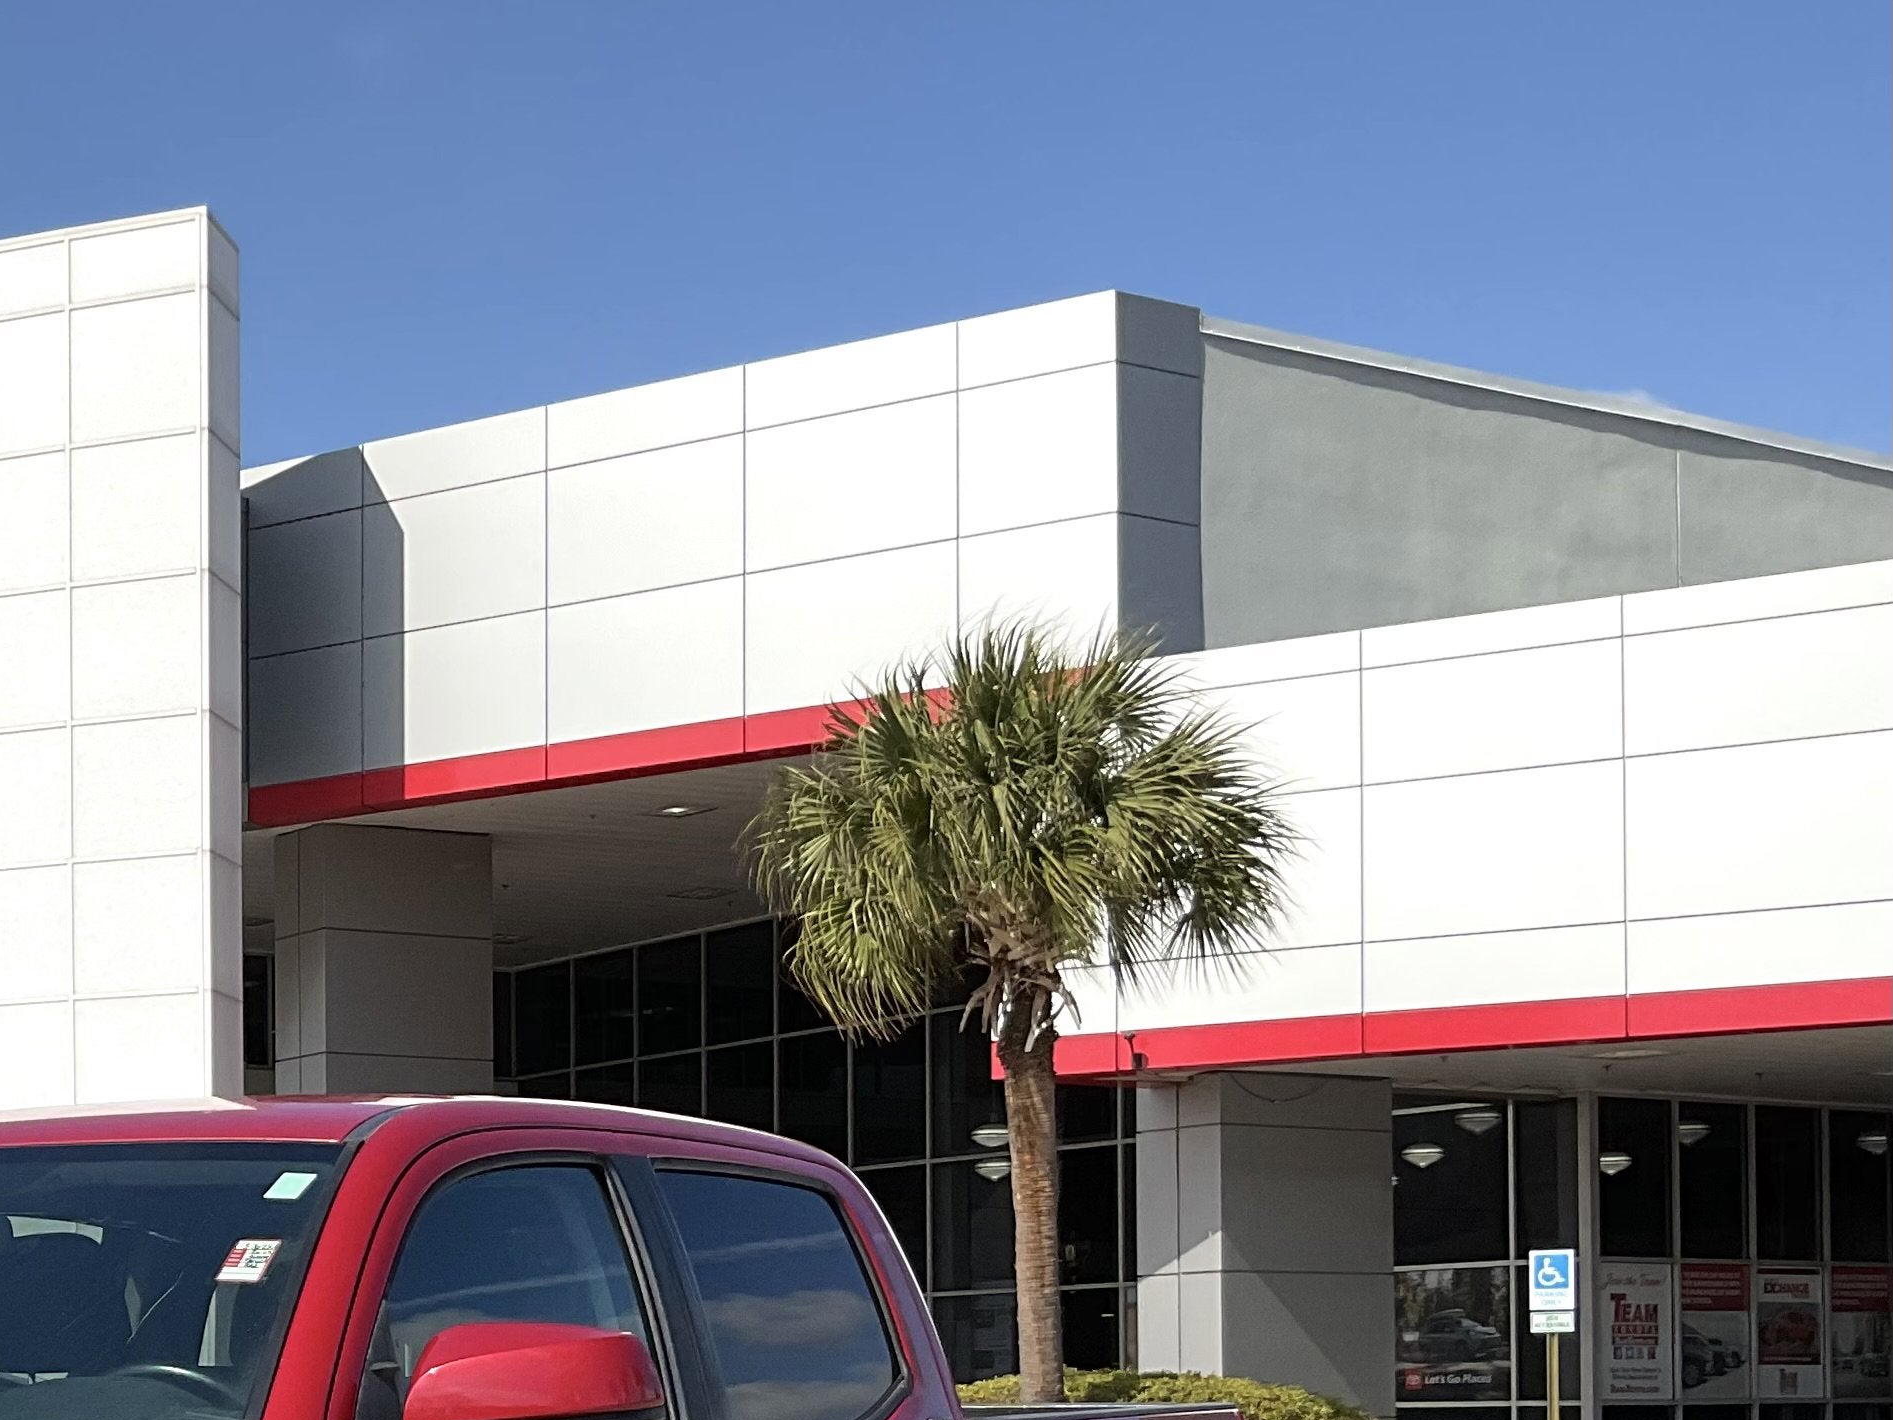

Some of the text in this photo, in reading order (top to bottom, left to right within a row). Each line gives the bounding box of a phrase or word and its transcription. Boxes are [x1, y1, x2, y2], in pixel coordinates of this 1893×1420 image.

[1610, 1293, 1659, 1323] TEAM
[1424, 1374, 1446, 1385] Let's
[1447, 1374, 1461, 1385] Go
